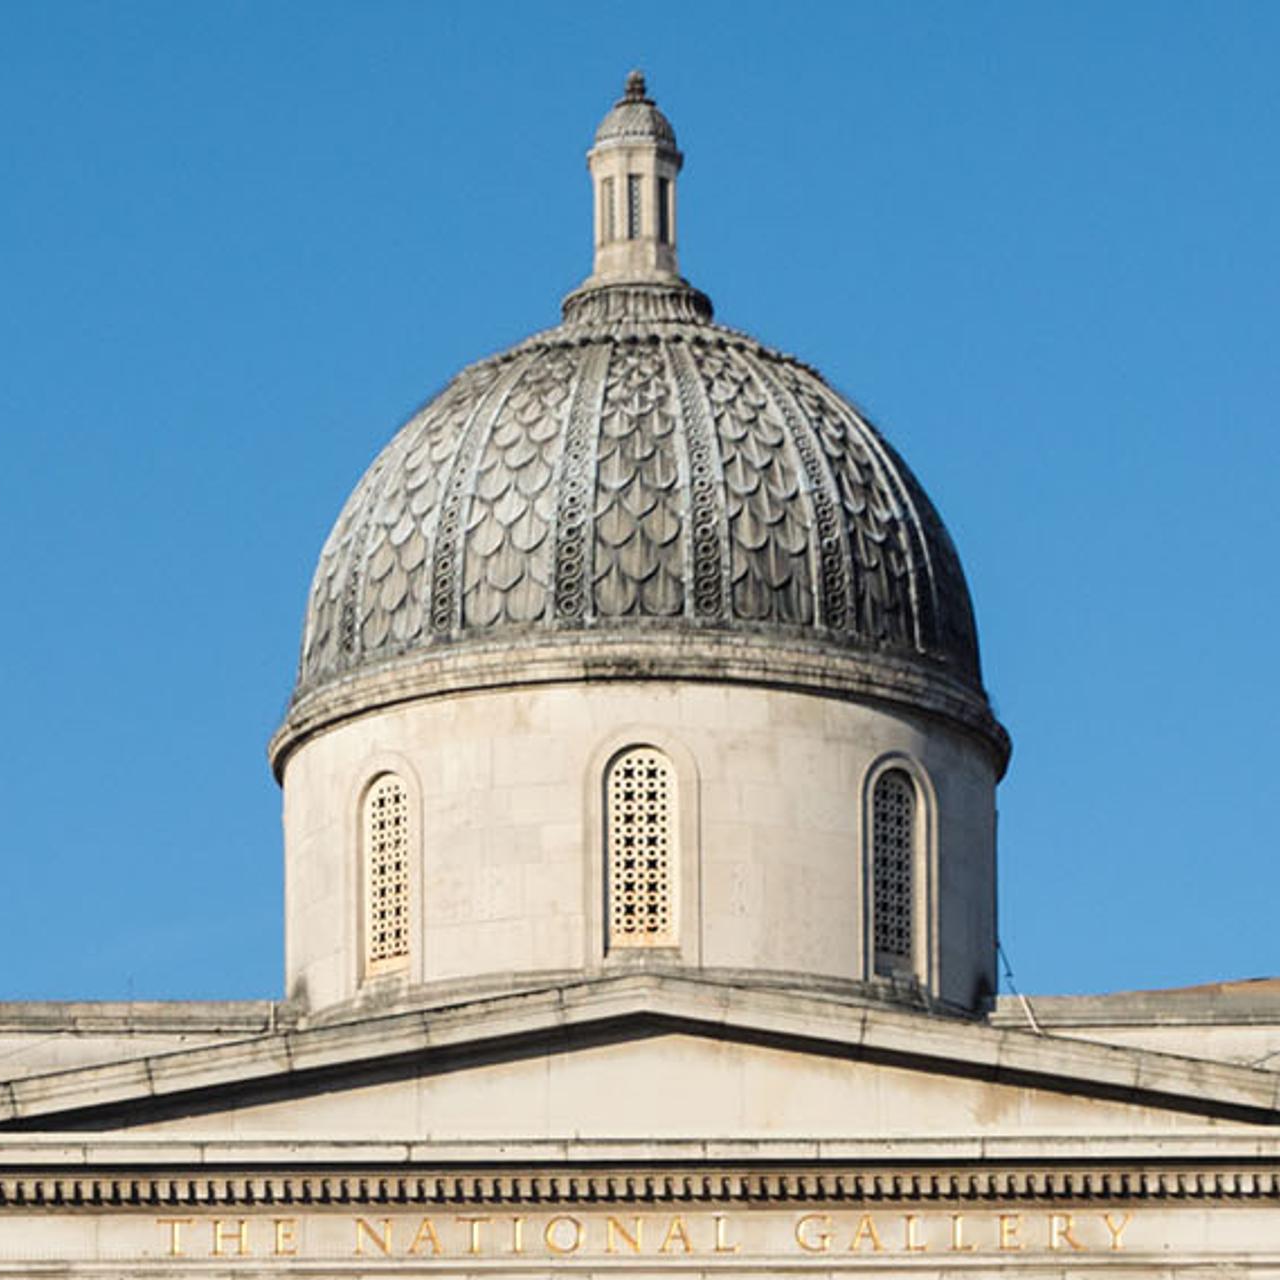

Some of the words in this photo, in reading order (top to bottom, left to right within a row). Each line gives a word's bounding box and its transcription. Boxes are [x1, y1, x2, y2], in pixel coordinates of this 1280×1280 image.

[157, 1217, 301, 1257] THE
[353, 1214, 741, 1255] NATIONAL
[794, 1212, 1138, 1254] GALLERY
